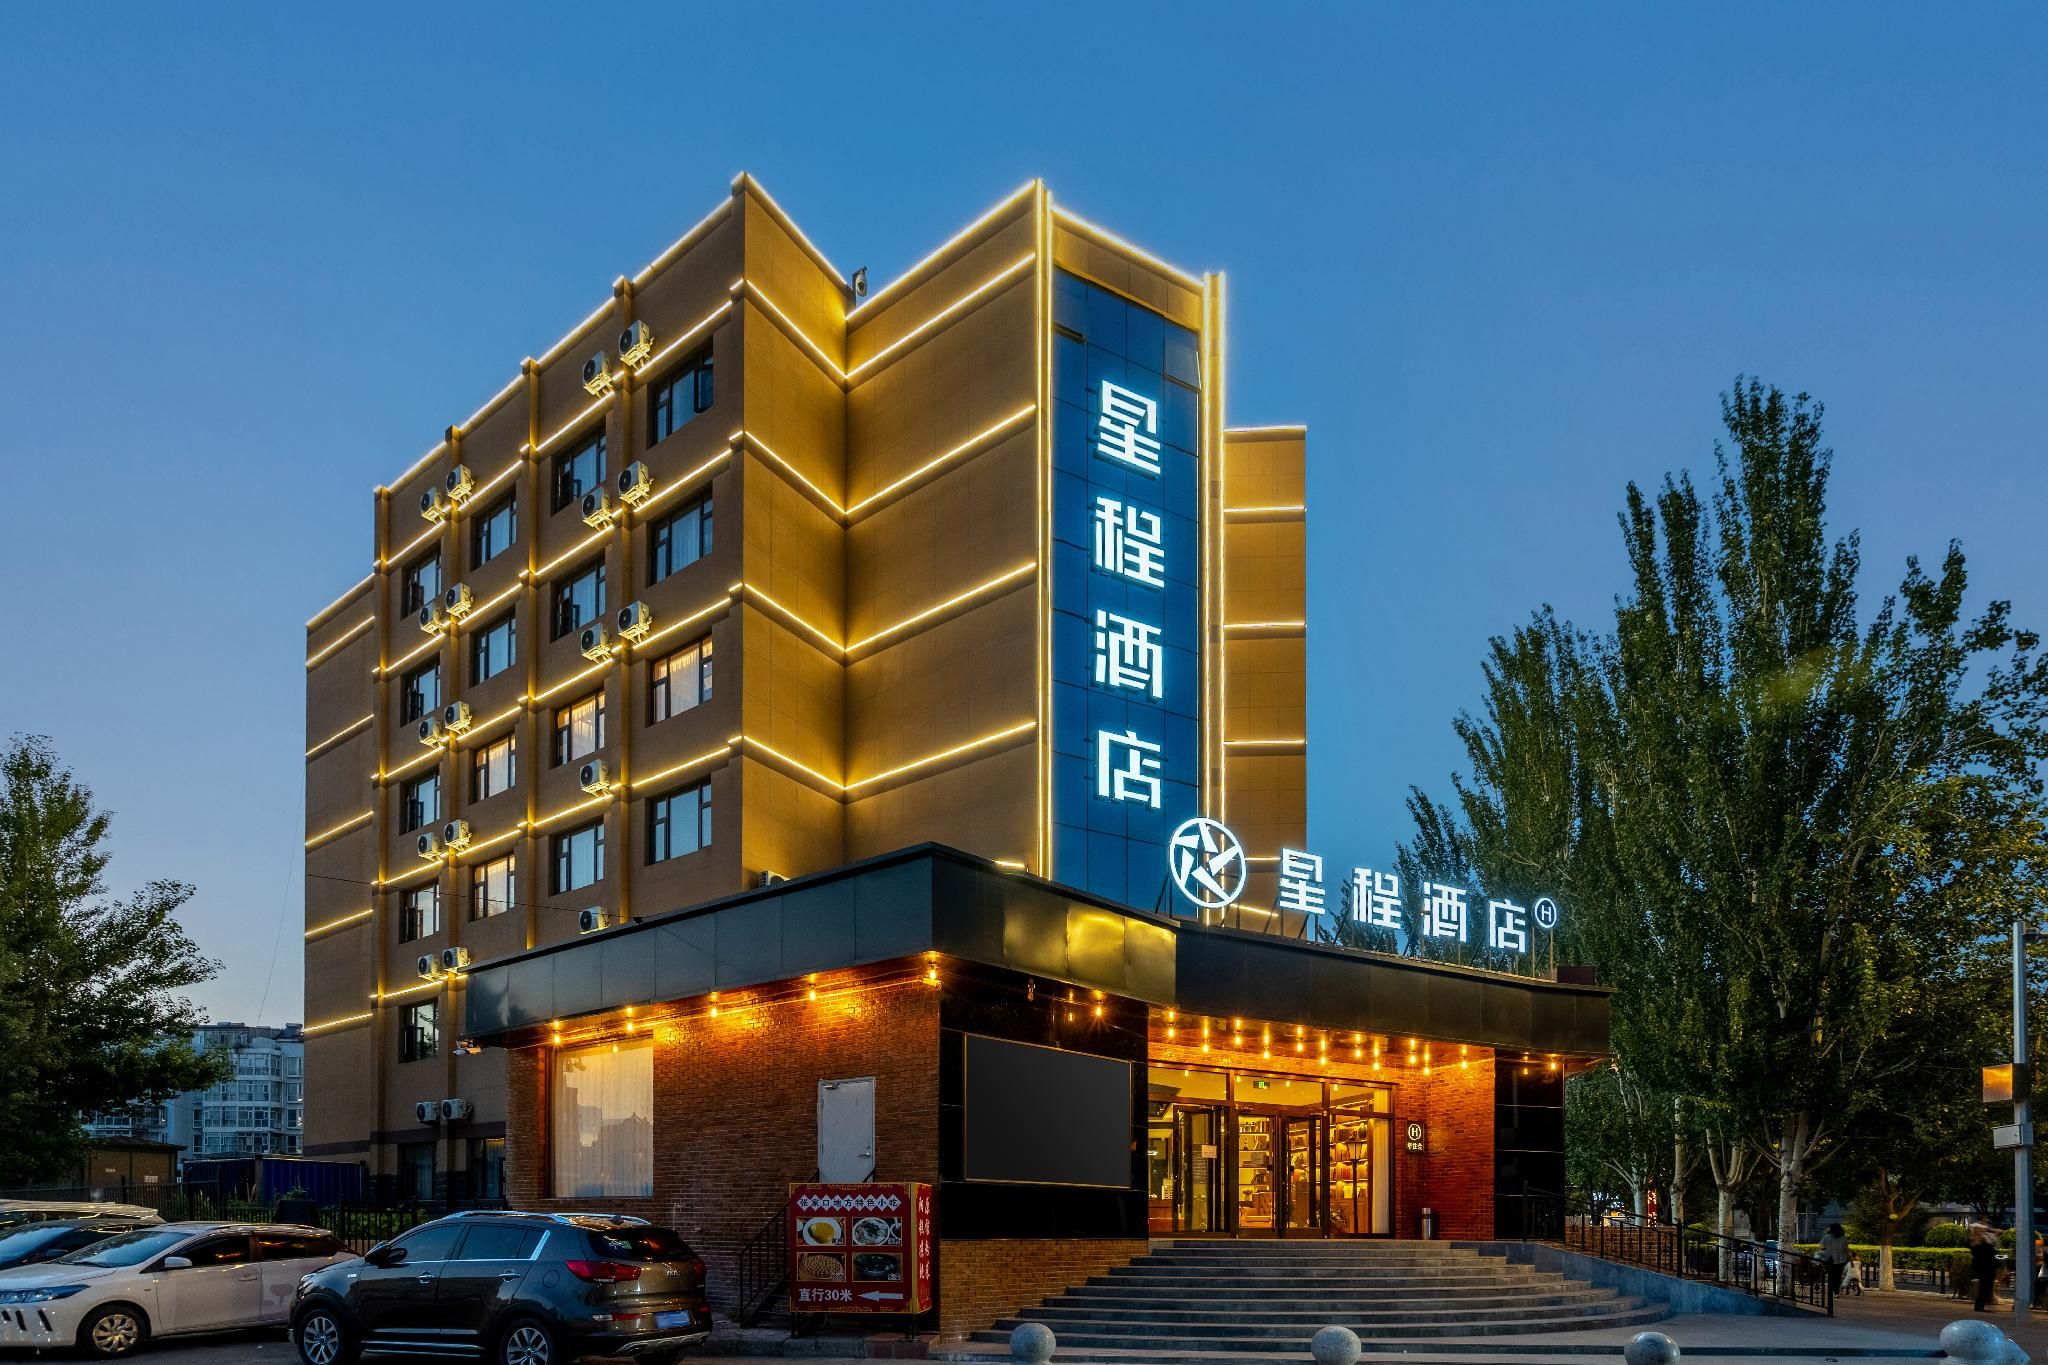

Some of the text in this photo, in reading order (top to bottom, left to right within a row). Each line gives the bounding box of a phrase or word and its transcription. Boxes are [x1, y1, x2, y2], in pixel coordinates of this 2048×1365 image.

[1095, 380, 1165, 809] 星程酒店
[1279, 847, 1526, 953] 星程酒店
[800, 1198, 898, 1208] 张家口地方特色小吃
[798, 1287, 853, 1302] 直行30米
